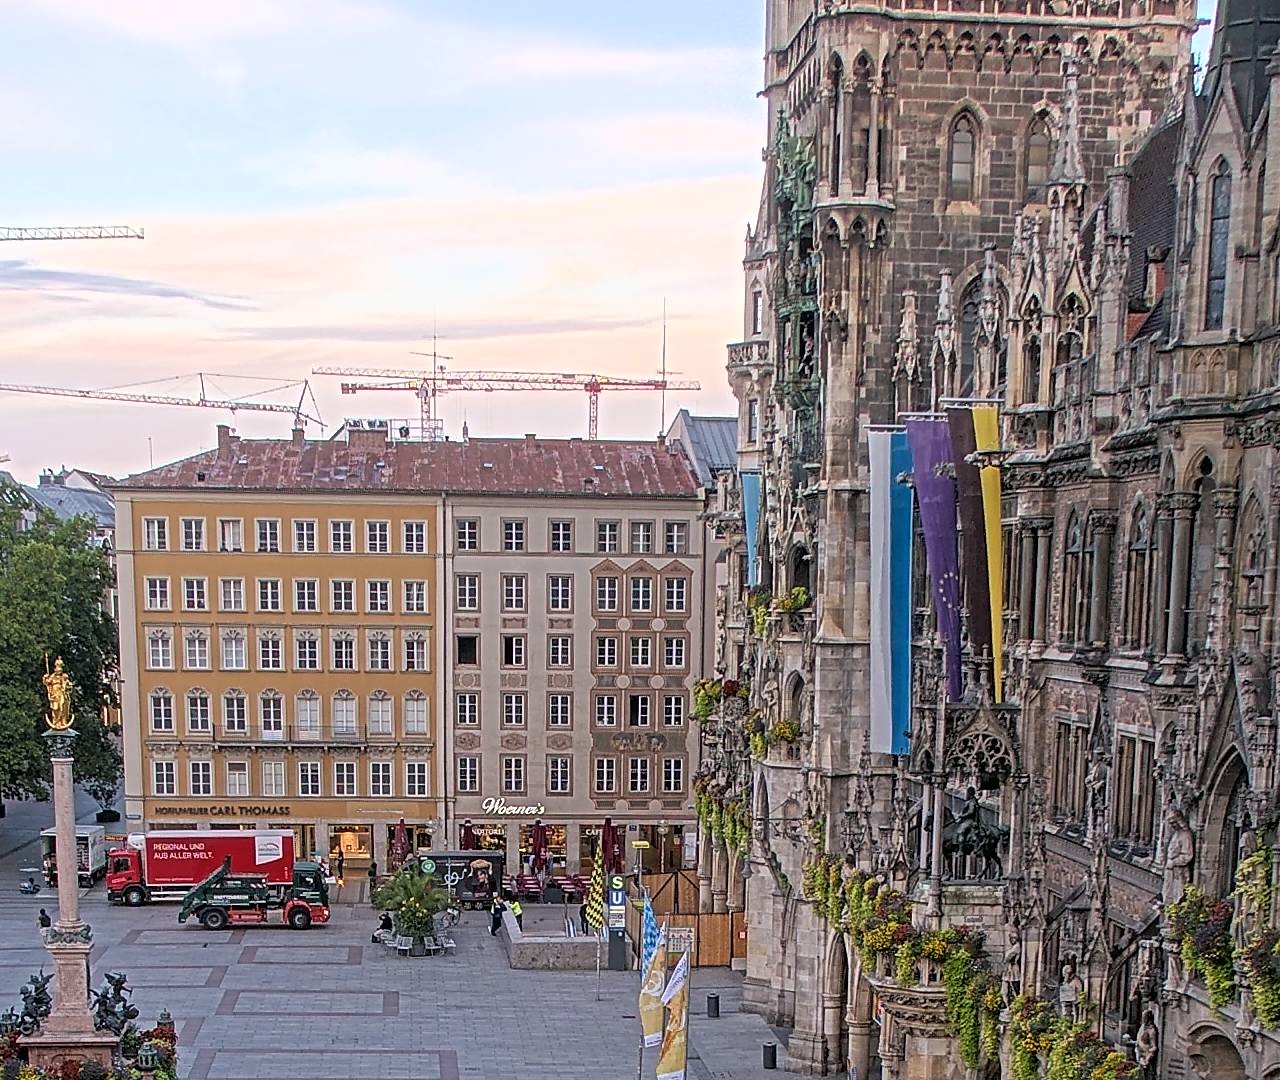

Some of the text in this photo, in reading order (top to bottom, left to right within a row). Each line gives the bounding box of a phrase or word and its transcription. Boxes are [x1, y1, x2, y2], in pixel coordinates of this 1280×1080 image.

[210, 806, 236, 816] CARL
[238, 806, 290, 816] THOMASS
[612, 876, 624, 890] S
[612, 891, 623, 904] U
